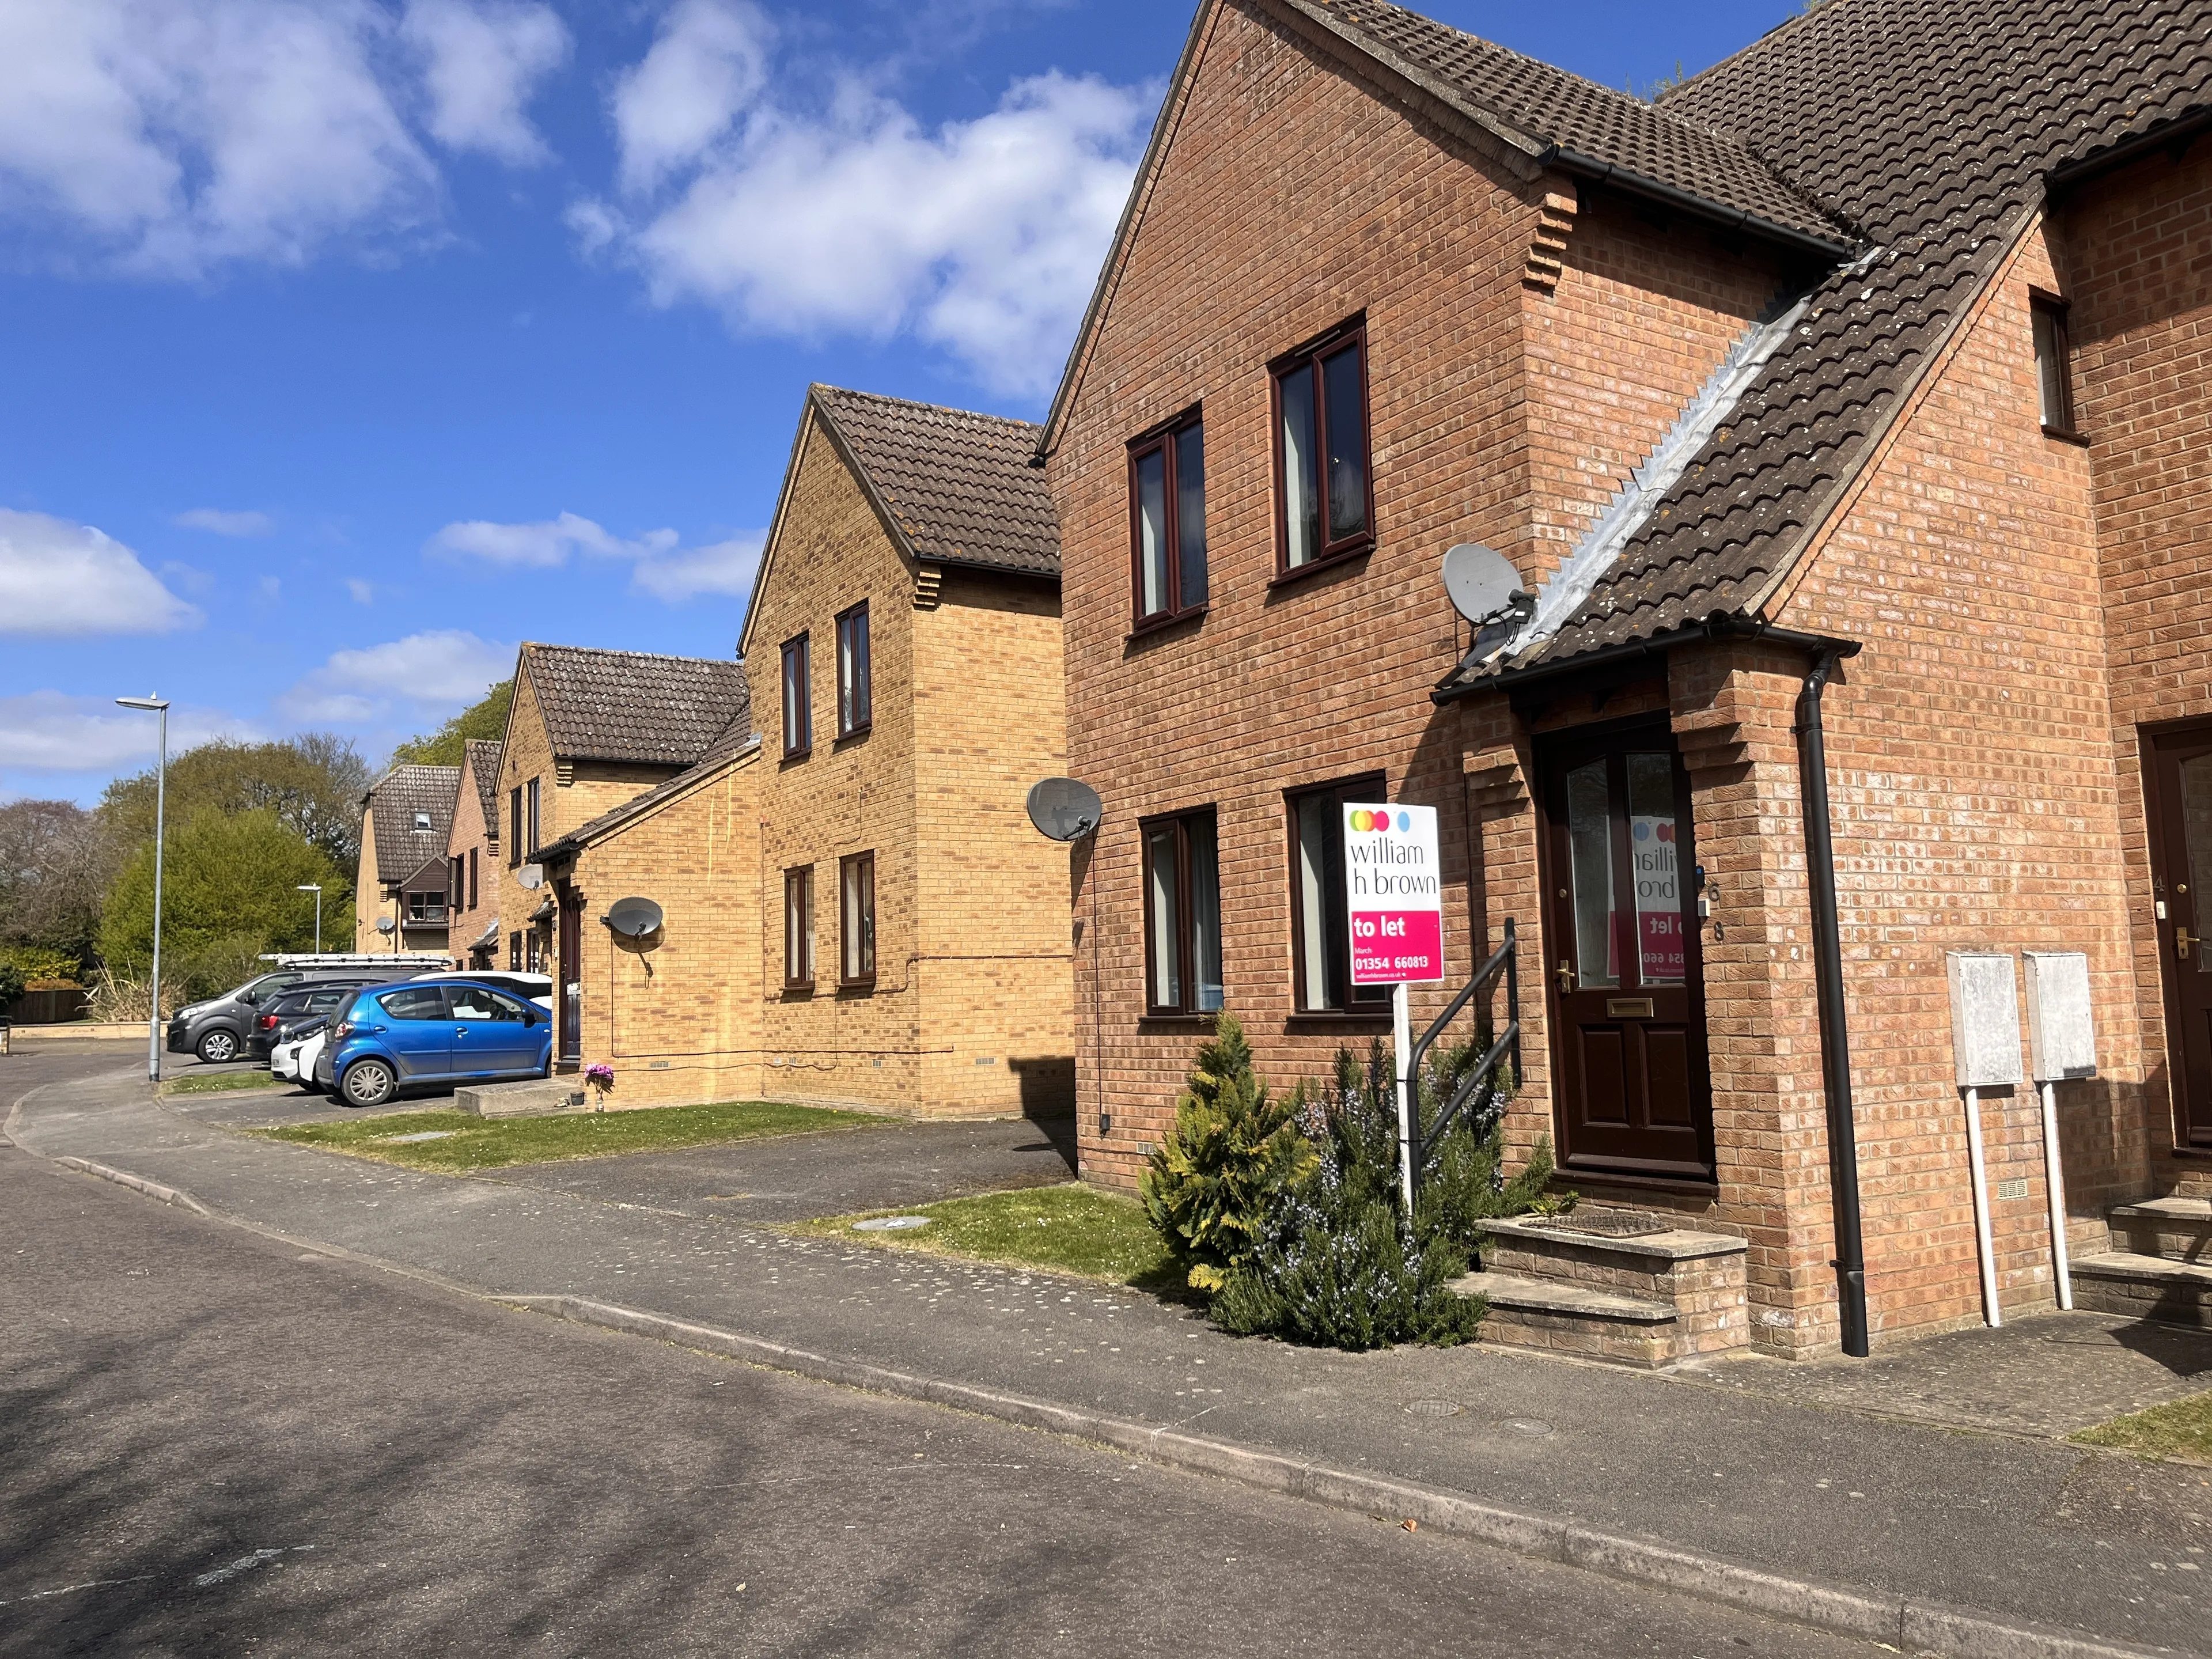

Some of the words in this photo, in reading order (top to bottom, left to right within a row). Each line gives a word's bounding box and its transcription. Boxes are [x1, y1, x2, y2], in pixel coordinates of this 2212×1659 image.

[1350, 837, 1423, 864] william
[1354, 868, 1366, 894] h
[1374, 868, 1436, 895] brown
[2153, 874, 2165, 892] 4
[1708, 882, 1720, 902] 6
[1354, 917, 1375, 937] to
[1381, 915, 1406, 937] let
[1714, 921, 1724, 941] 8
[1354, 946, 1372, 955] March
[1355, 956, 1390, 970] 01354
[1394, 955, 1428, 969] 660813
